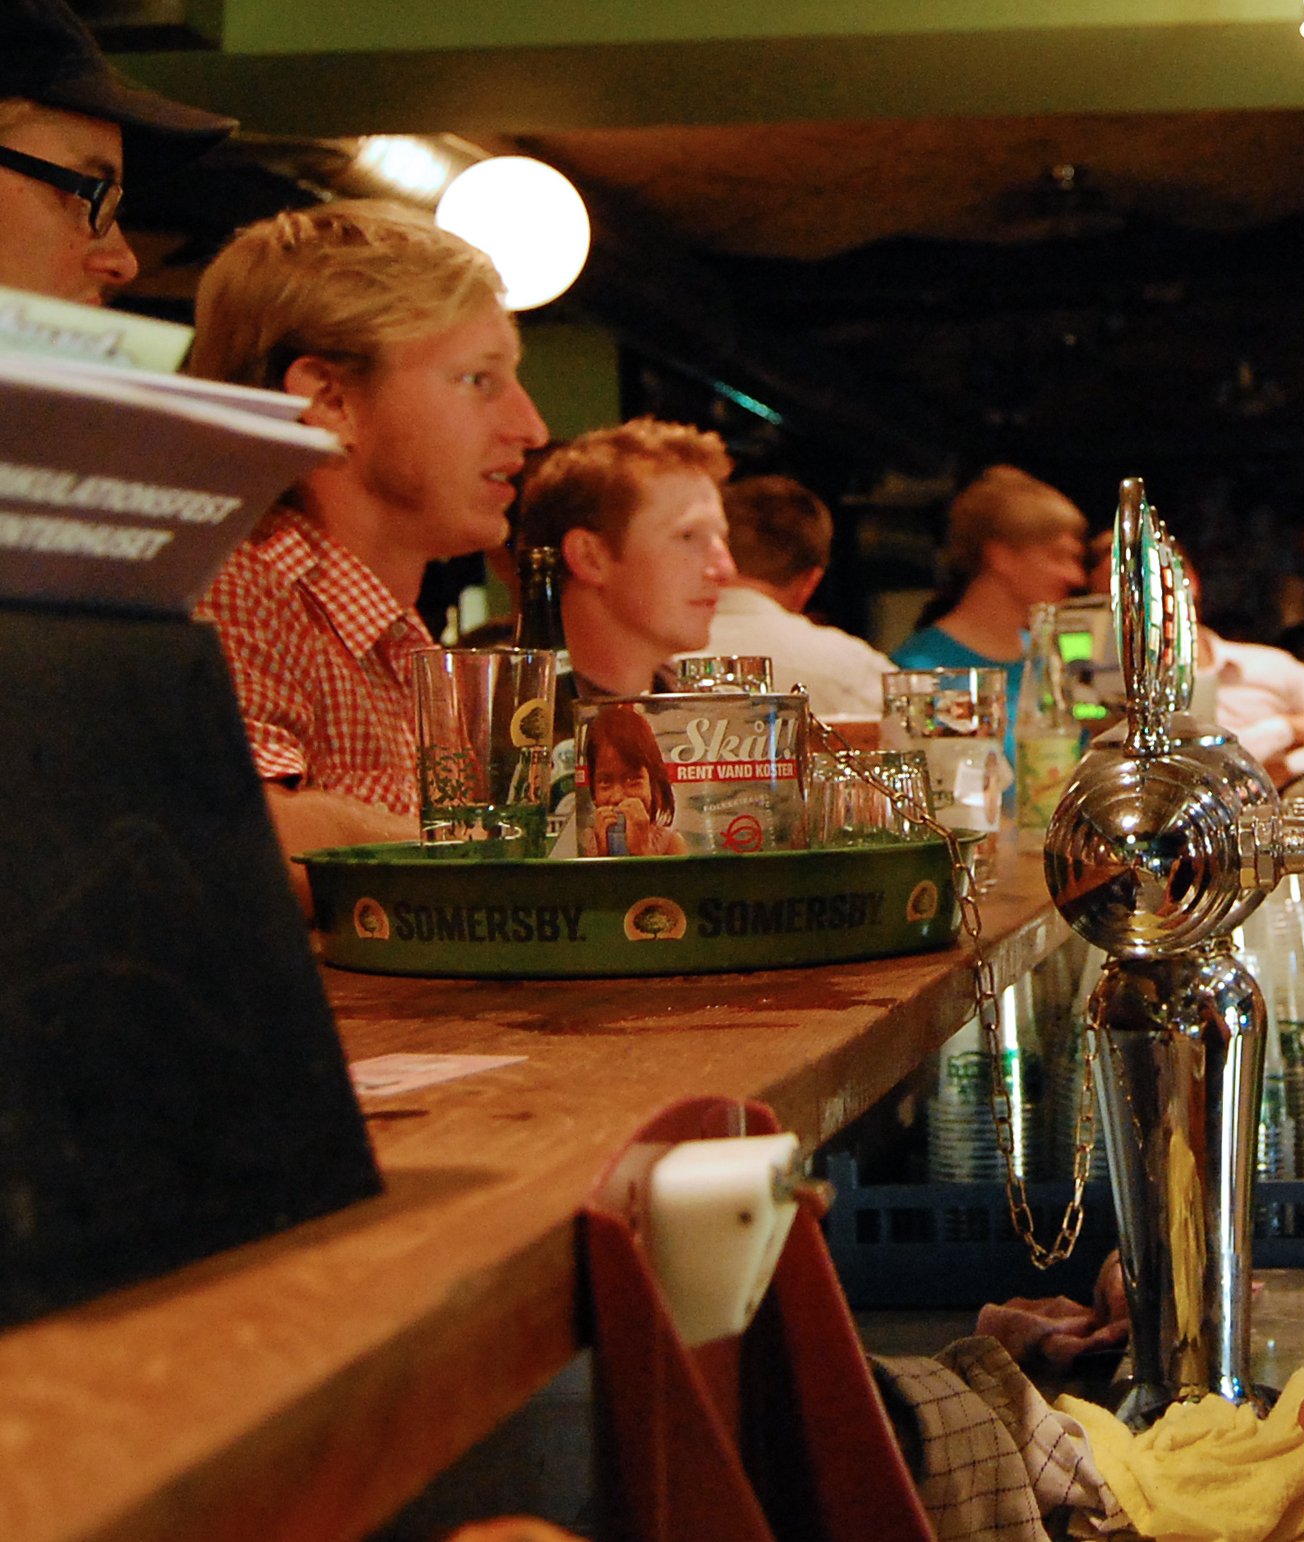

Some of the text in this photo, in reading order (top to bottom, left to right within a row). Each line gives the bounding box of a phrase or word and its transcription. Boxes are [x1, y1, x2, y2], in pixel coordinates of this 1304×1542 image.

[672, 718, 796, 763] Skål!
[677, 763, 793, 780] RENT VAND KOSTER
